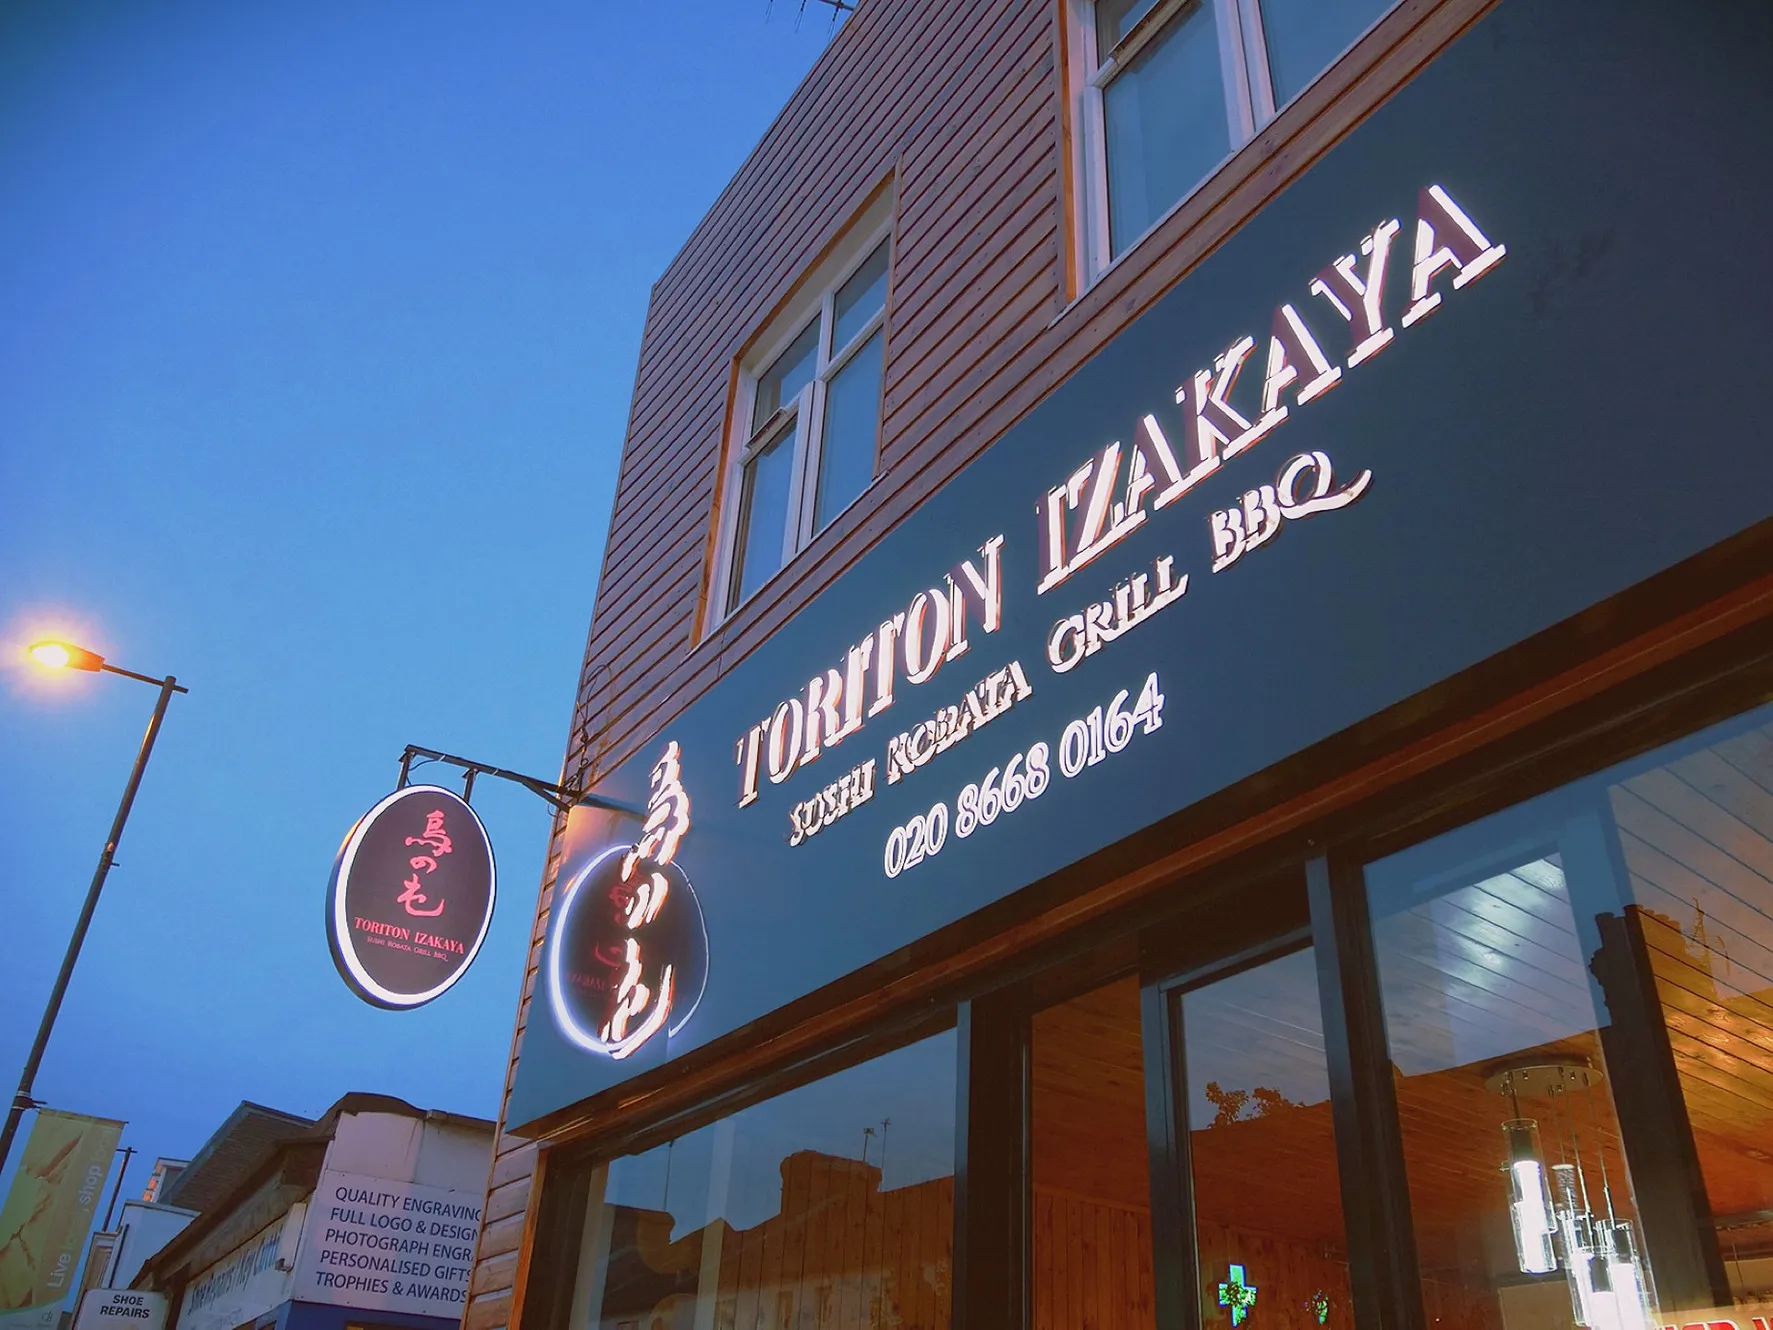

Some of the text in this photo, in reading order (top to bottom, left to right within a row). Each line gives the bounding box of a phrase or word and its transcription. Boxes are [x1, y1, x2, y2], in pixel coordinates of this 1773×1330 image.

[735, 184, 1507, 809] TORITON IZAKAYA
[788, 451, 1374, 847] SUSHI ROBATA GRILL BBQ
[884, 672, 1165, 879] 020 8668 0164
[354, 916, 465, 955] TORITON IZAKAYA
[335, 1186, 400, 1209] QUALITY
[330, 1207, 366, 1225] FULL
[369, 1213, 413, 1232] LOGO
[415, 1221, 427, 1235] &
[325, 1228, 474, 1262] PHOTOGRAPH ENGR
[47, 1252, 72, 1290] Live
[320, 1250, 431, 1277] PERSONALISED
[113, 1294, 144, 1306] SHOE
[316, 1271, 467, 1303] TROPHIES & AWARDS
[100, 1306, 150, 1319] REPAIRS
